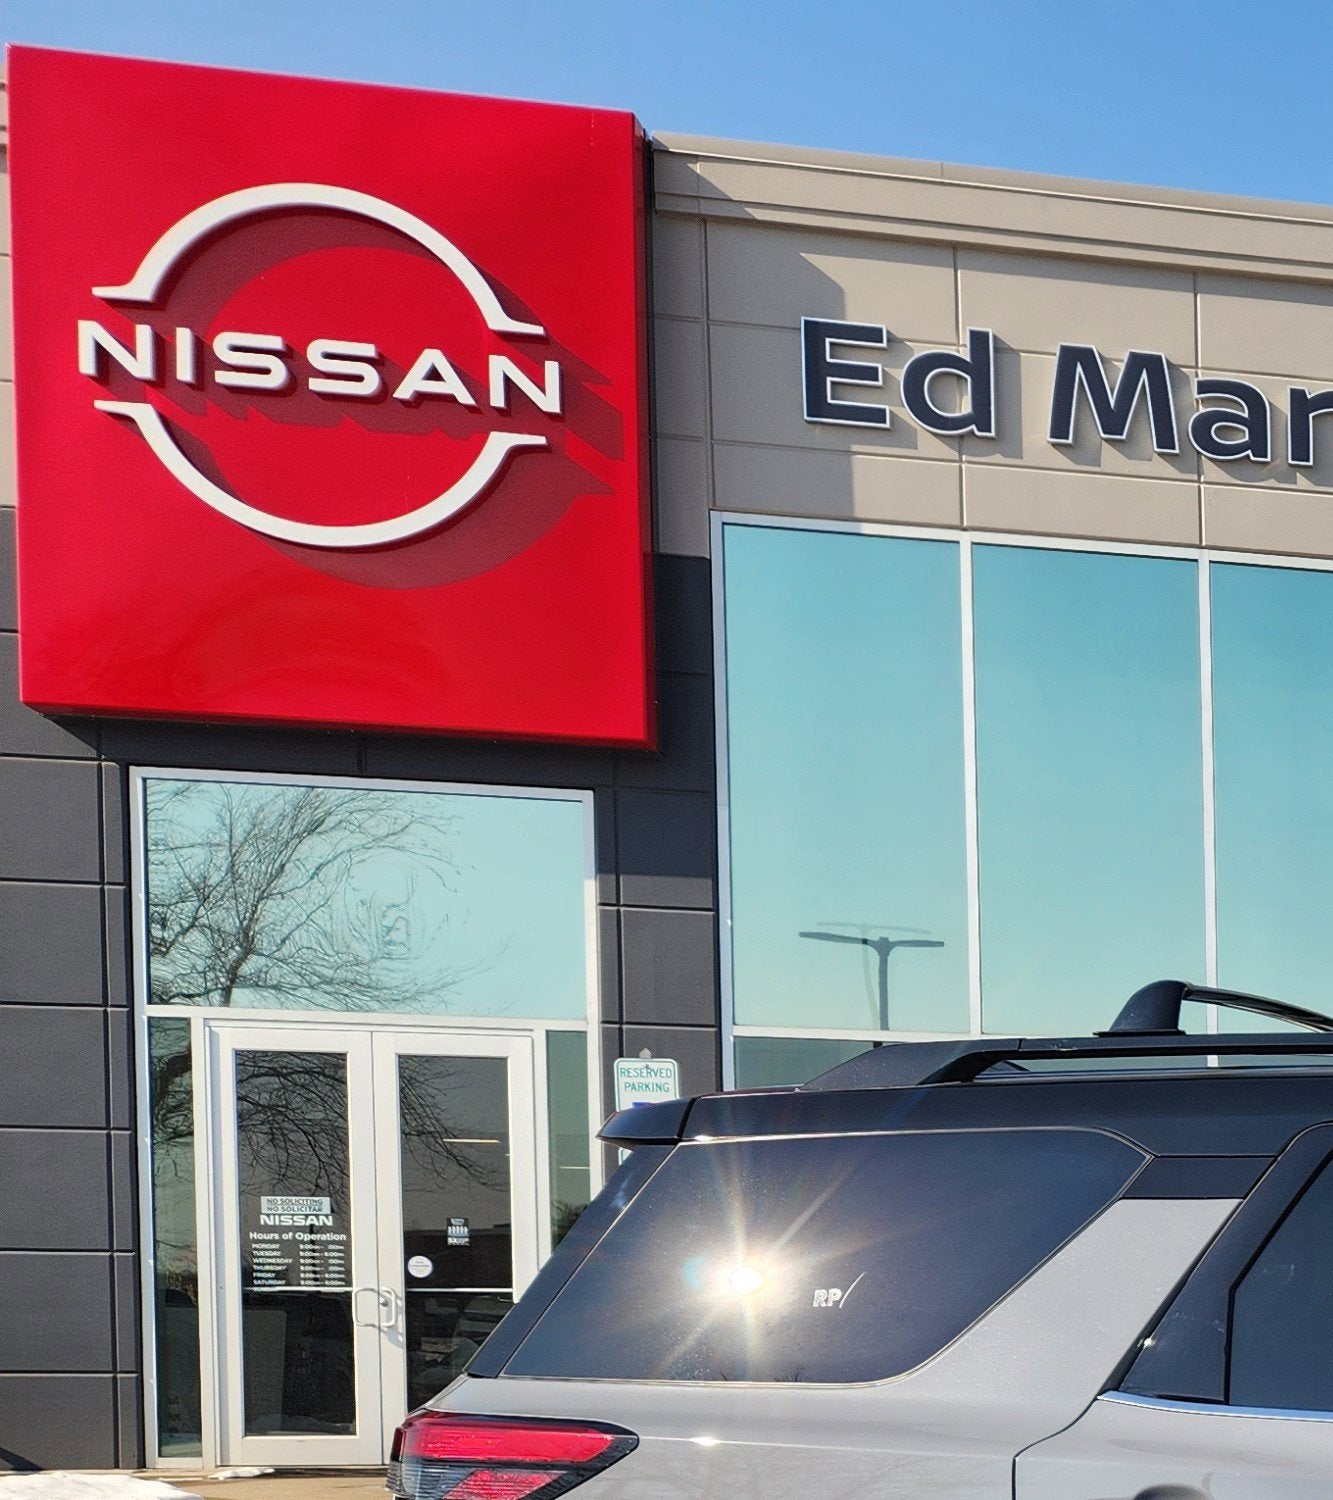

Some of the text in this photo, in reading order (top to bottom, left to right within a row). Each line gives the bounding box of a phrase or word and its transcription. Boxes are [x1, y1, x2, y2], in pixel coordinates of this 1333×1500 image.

[78, 320, 562, 415] NISSAN
[800, 317, 996, 438] Ed
[620, 1067, 673, 1079] RESERVED
[624, 1082, 670, 1093] PARKING
[260, 1214, 333, 1226] NISSAN
[249, 1231, 347, 1241] Hours of Operation
